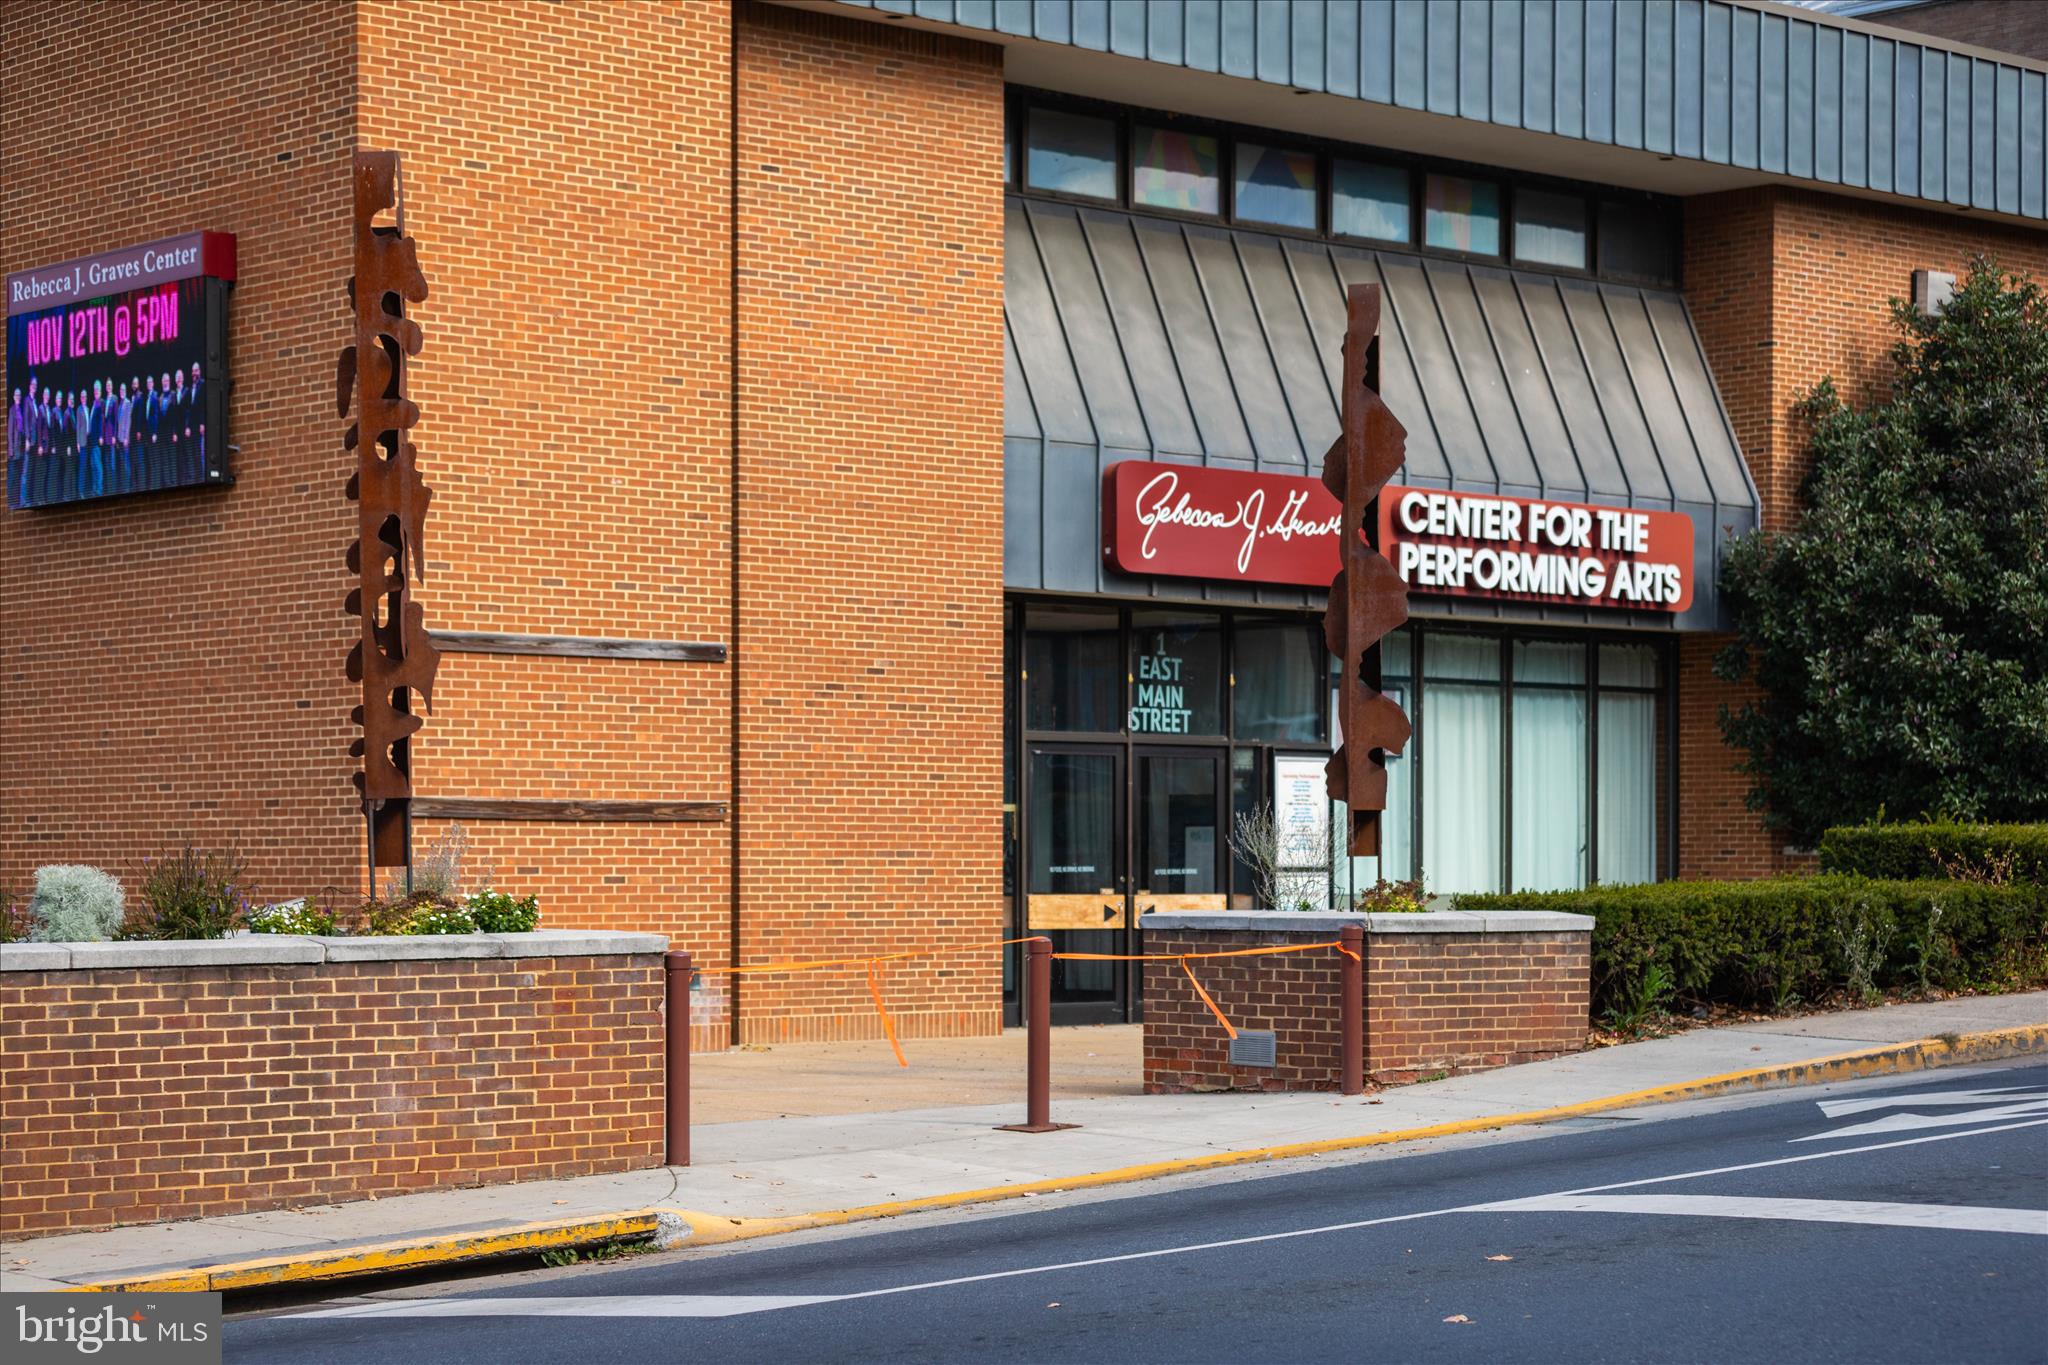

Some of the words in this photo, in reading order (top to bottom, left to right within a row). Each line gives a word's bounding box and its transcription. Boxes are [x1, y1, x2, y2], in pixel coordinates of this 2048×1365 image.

[12, 276, 72, 303] Rebecca
[73, 266, 86, 296] J.
[89, 261, 141, 286] Graves
[143, 247, 198, 273] Center
[27, 314, 63, 367] NOV
[69, 305, 109, 358] 12TH
[114, 305, 131, 356] @
[136, 291, 179, 346] 5PM
[1136, 471, 1243, 560] Rebecca
[1266, 489, 1342, 542] Grave
[1400, 491, 1522, 542] CENTER
[1528, 503, 1593, 549] FOR
[1597, 510, 1650, 553] THE
[1399, 542, 1607, 598] PERFORMING
[1610, 560, 1682, 604] ARTS
[1140, 655, 1183, 681] EAST
[1156, 632, 1167, 656] 1
[1131, 707, 1192, 733] STREET
[1138, 684, 1184, 708] MAIN
